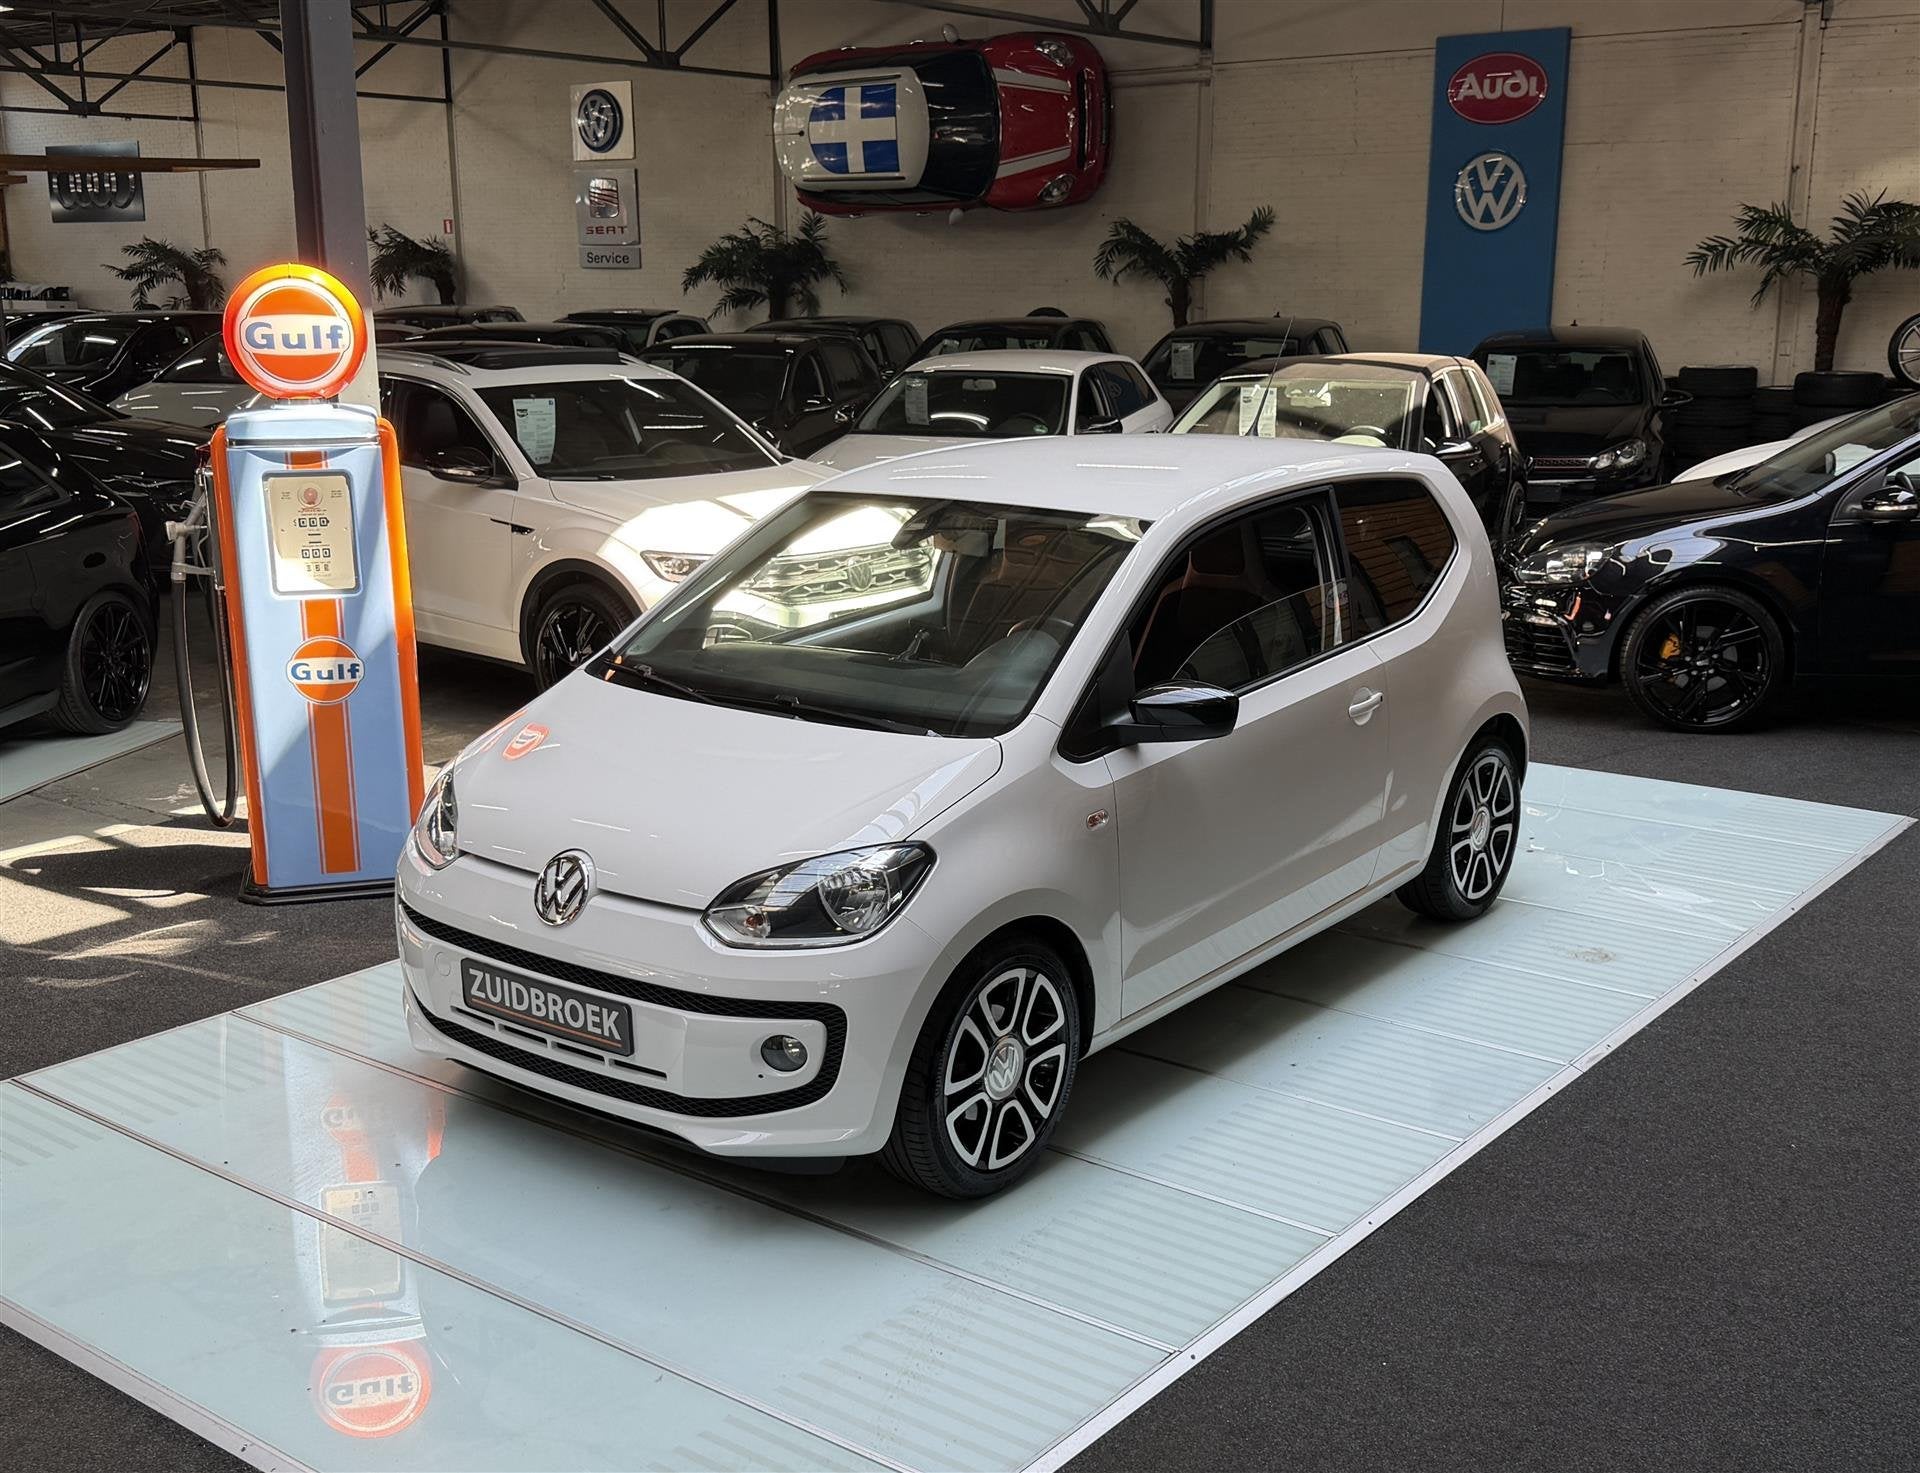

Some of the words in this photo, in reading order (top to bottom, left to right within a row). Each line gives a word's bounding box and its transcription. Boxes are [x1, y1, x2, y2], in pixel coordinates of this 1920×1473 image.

[1456, 69, 1539, 101] Audi
[586, 225, 628, 235] SEAT
[586, 251, 630, 265] Service
[245, 321, 344, 350] Gulf
[291, 662, 360, 681] Gulf
[468, 967, 622, 1041] ZUIDBROEK
